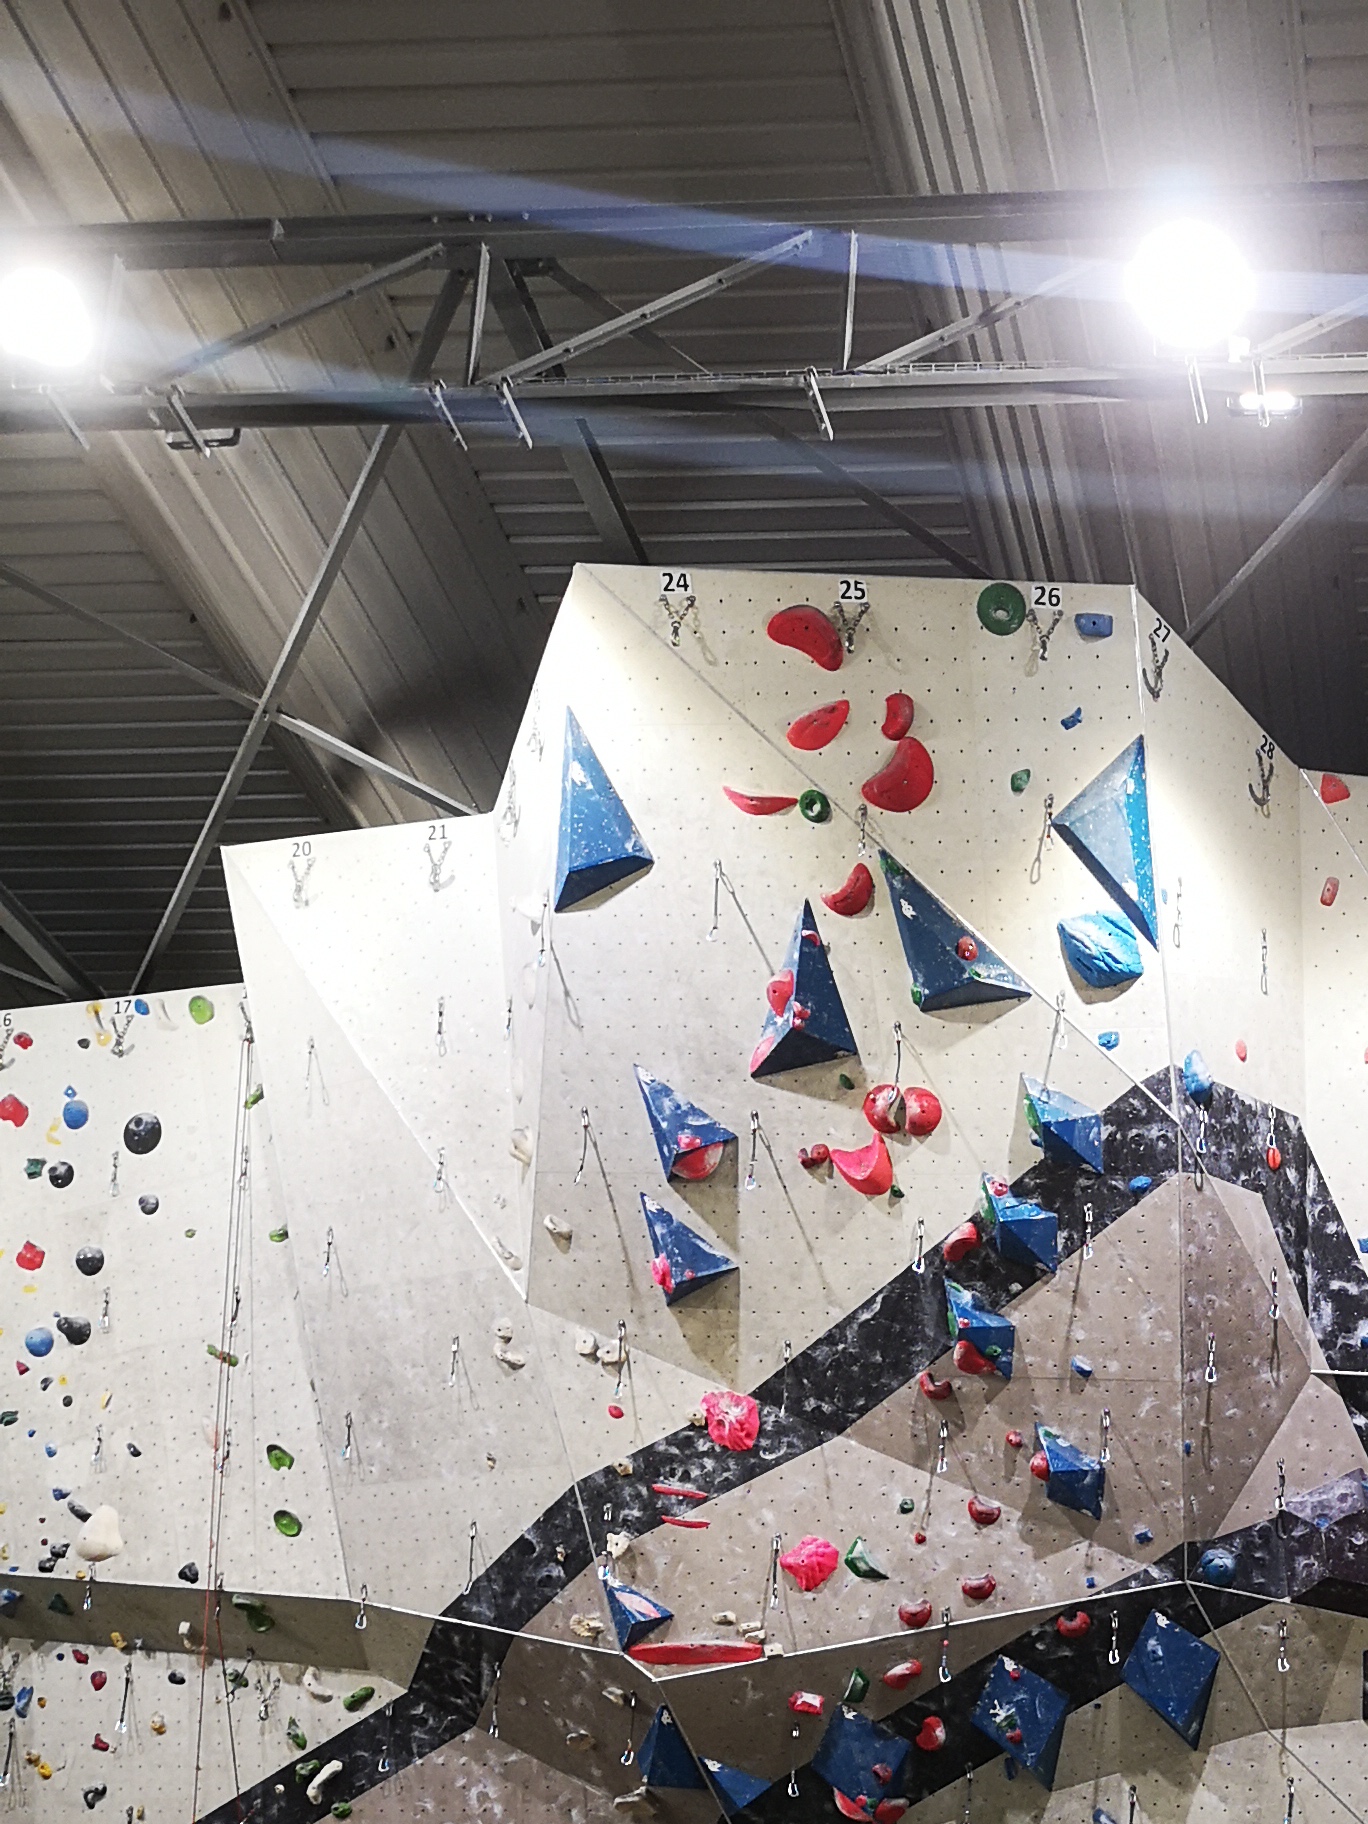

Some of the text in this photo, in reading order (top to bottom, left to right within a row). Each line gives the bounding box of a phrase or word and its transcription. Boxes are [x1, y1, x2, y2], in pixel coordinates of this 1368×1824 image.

[662, 572, 690, 592] 24
[839, 580, 867, 600] 25
[1034, 586, 1061, 607] 26
[1153, 617, 1171, 643] 27
[1260, 734, 1276, 760] 28
[427, 824, 449, 841] 21
[291, 841, 312, 858] 20
[113, 1000, 132, 1015] 17
